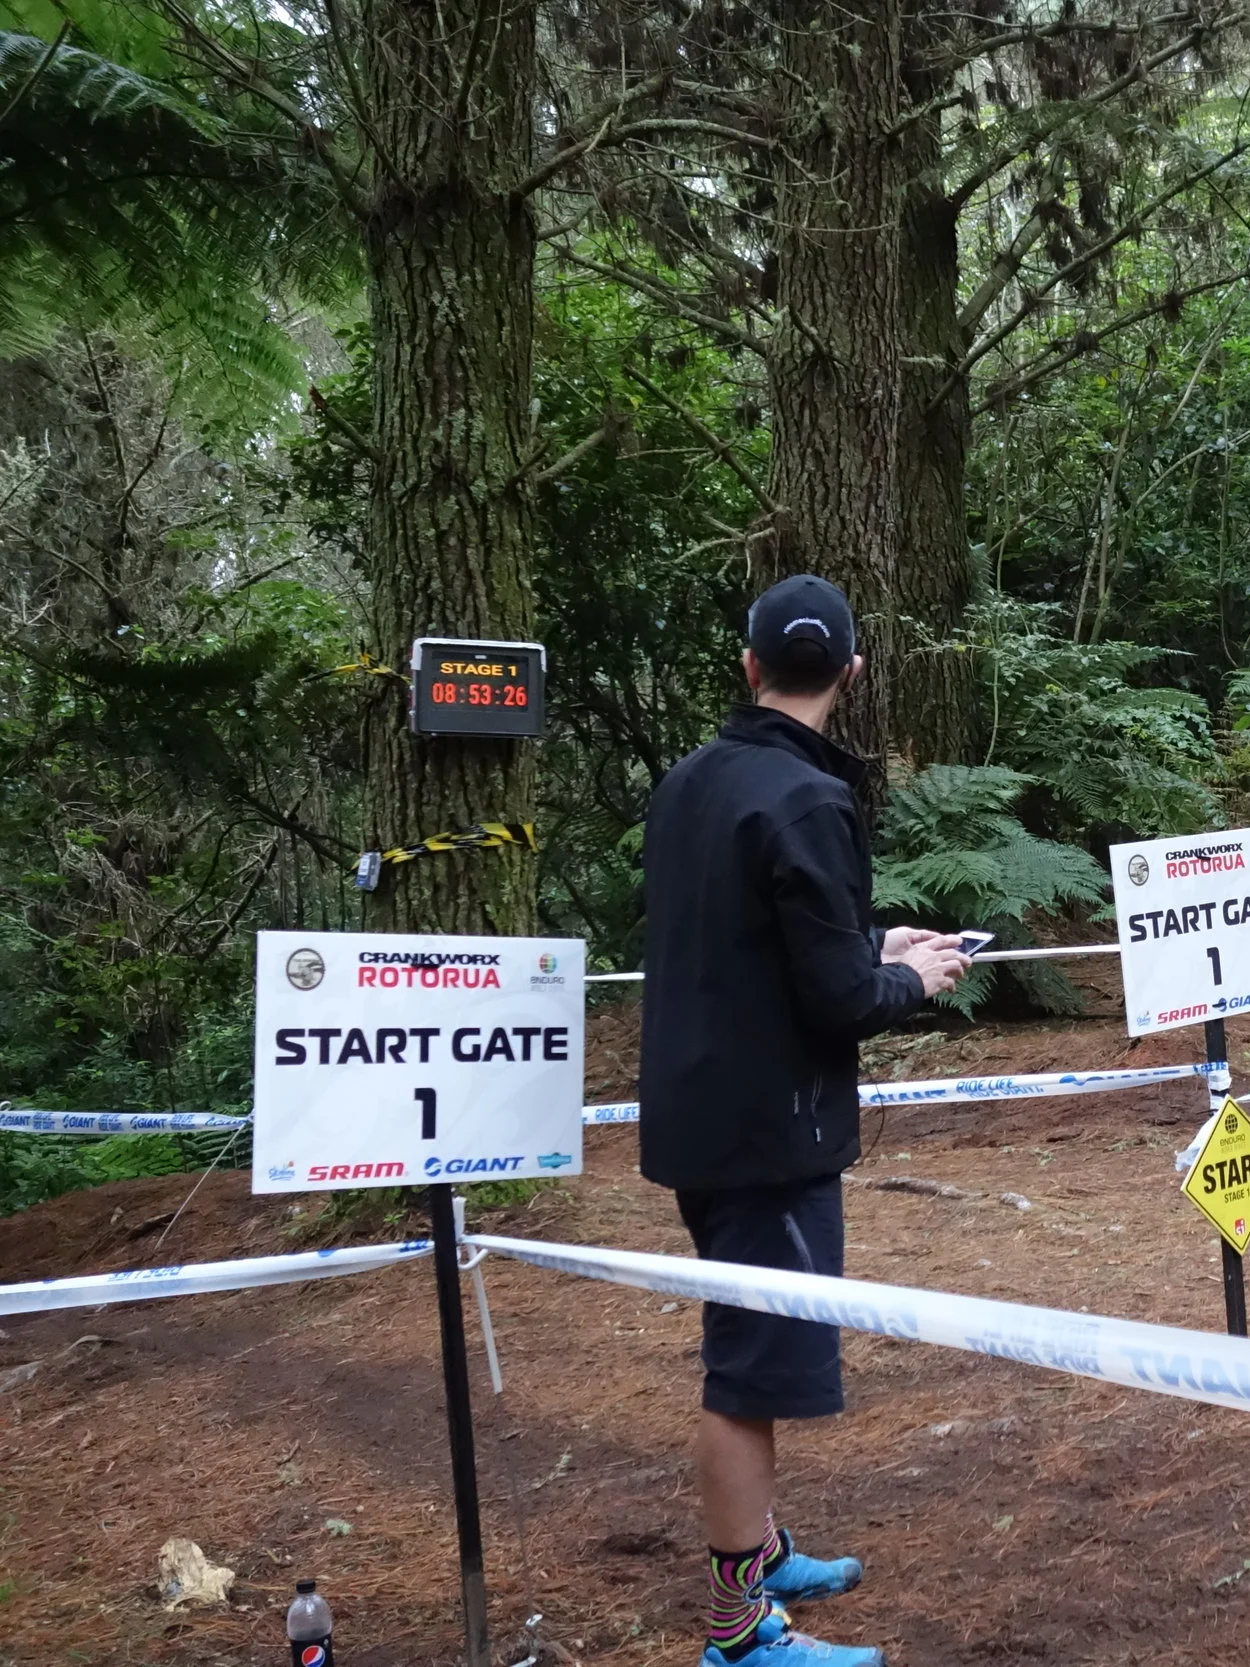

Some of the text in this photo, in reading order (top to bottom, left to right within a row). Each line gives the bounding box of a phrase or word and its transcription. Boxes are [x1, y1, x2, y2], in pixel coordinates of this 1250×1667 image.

[440, 662, 517, 677] STAGE 1
[432, 682, 527, 707] 08:53:26
[1165, 843, 1243, 861] CRANKWORX
[1167, 854, 1245, 878] ROTORUA
[1128, 902, 1216, 942] START
[358, 951, 500, 966] CRANKWORX
[1206, 946, 1222, 986] 1
[358, 966, 501, 988] ROTORUA
[1157, 1003, 1208, 1024] SRAM
[275, 1027, 568, 1066] START GATE
[956, 1080, 986, 1093] RIDE
[69, 1116, 96, 1128] GIANT
[138, 1118, 168, 1129] GIANT
[414, 1088, 436, 1140] 1
[307, 1162, 404, 1182] SRAM
[445, 1156, 525, 1173] GIANT
[1224, 1187, 1250, 1204] STAGE 1
